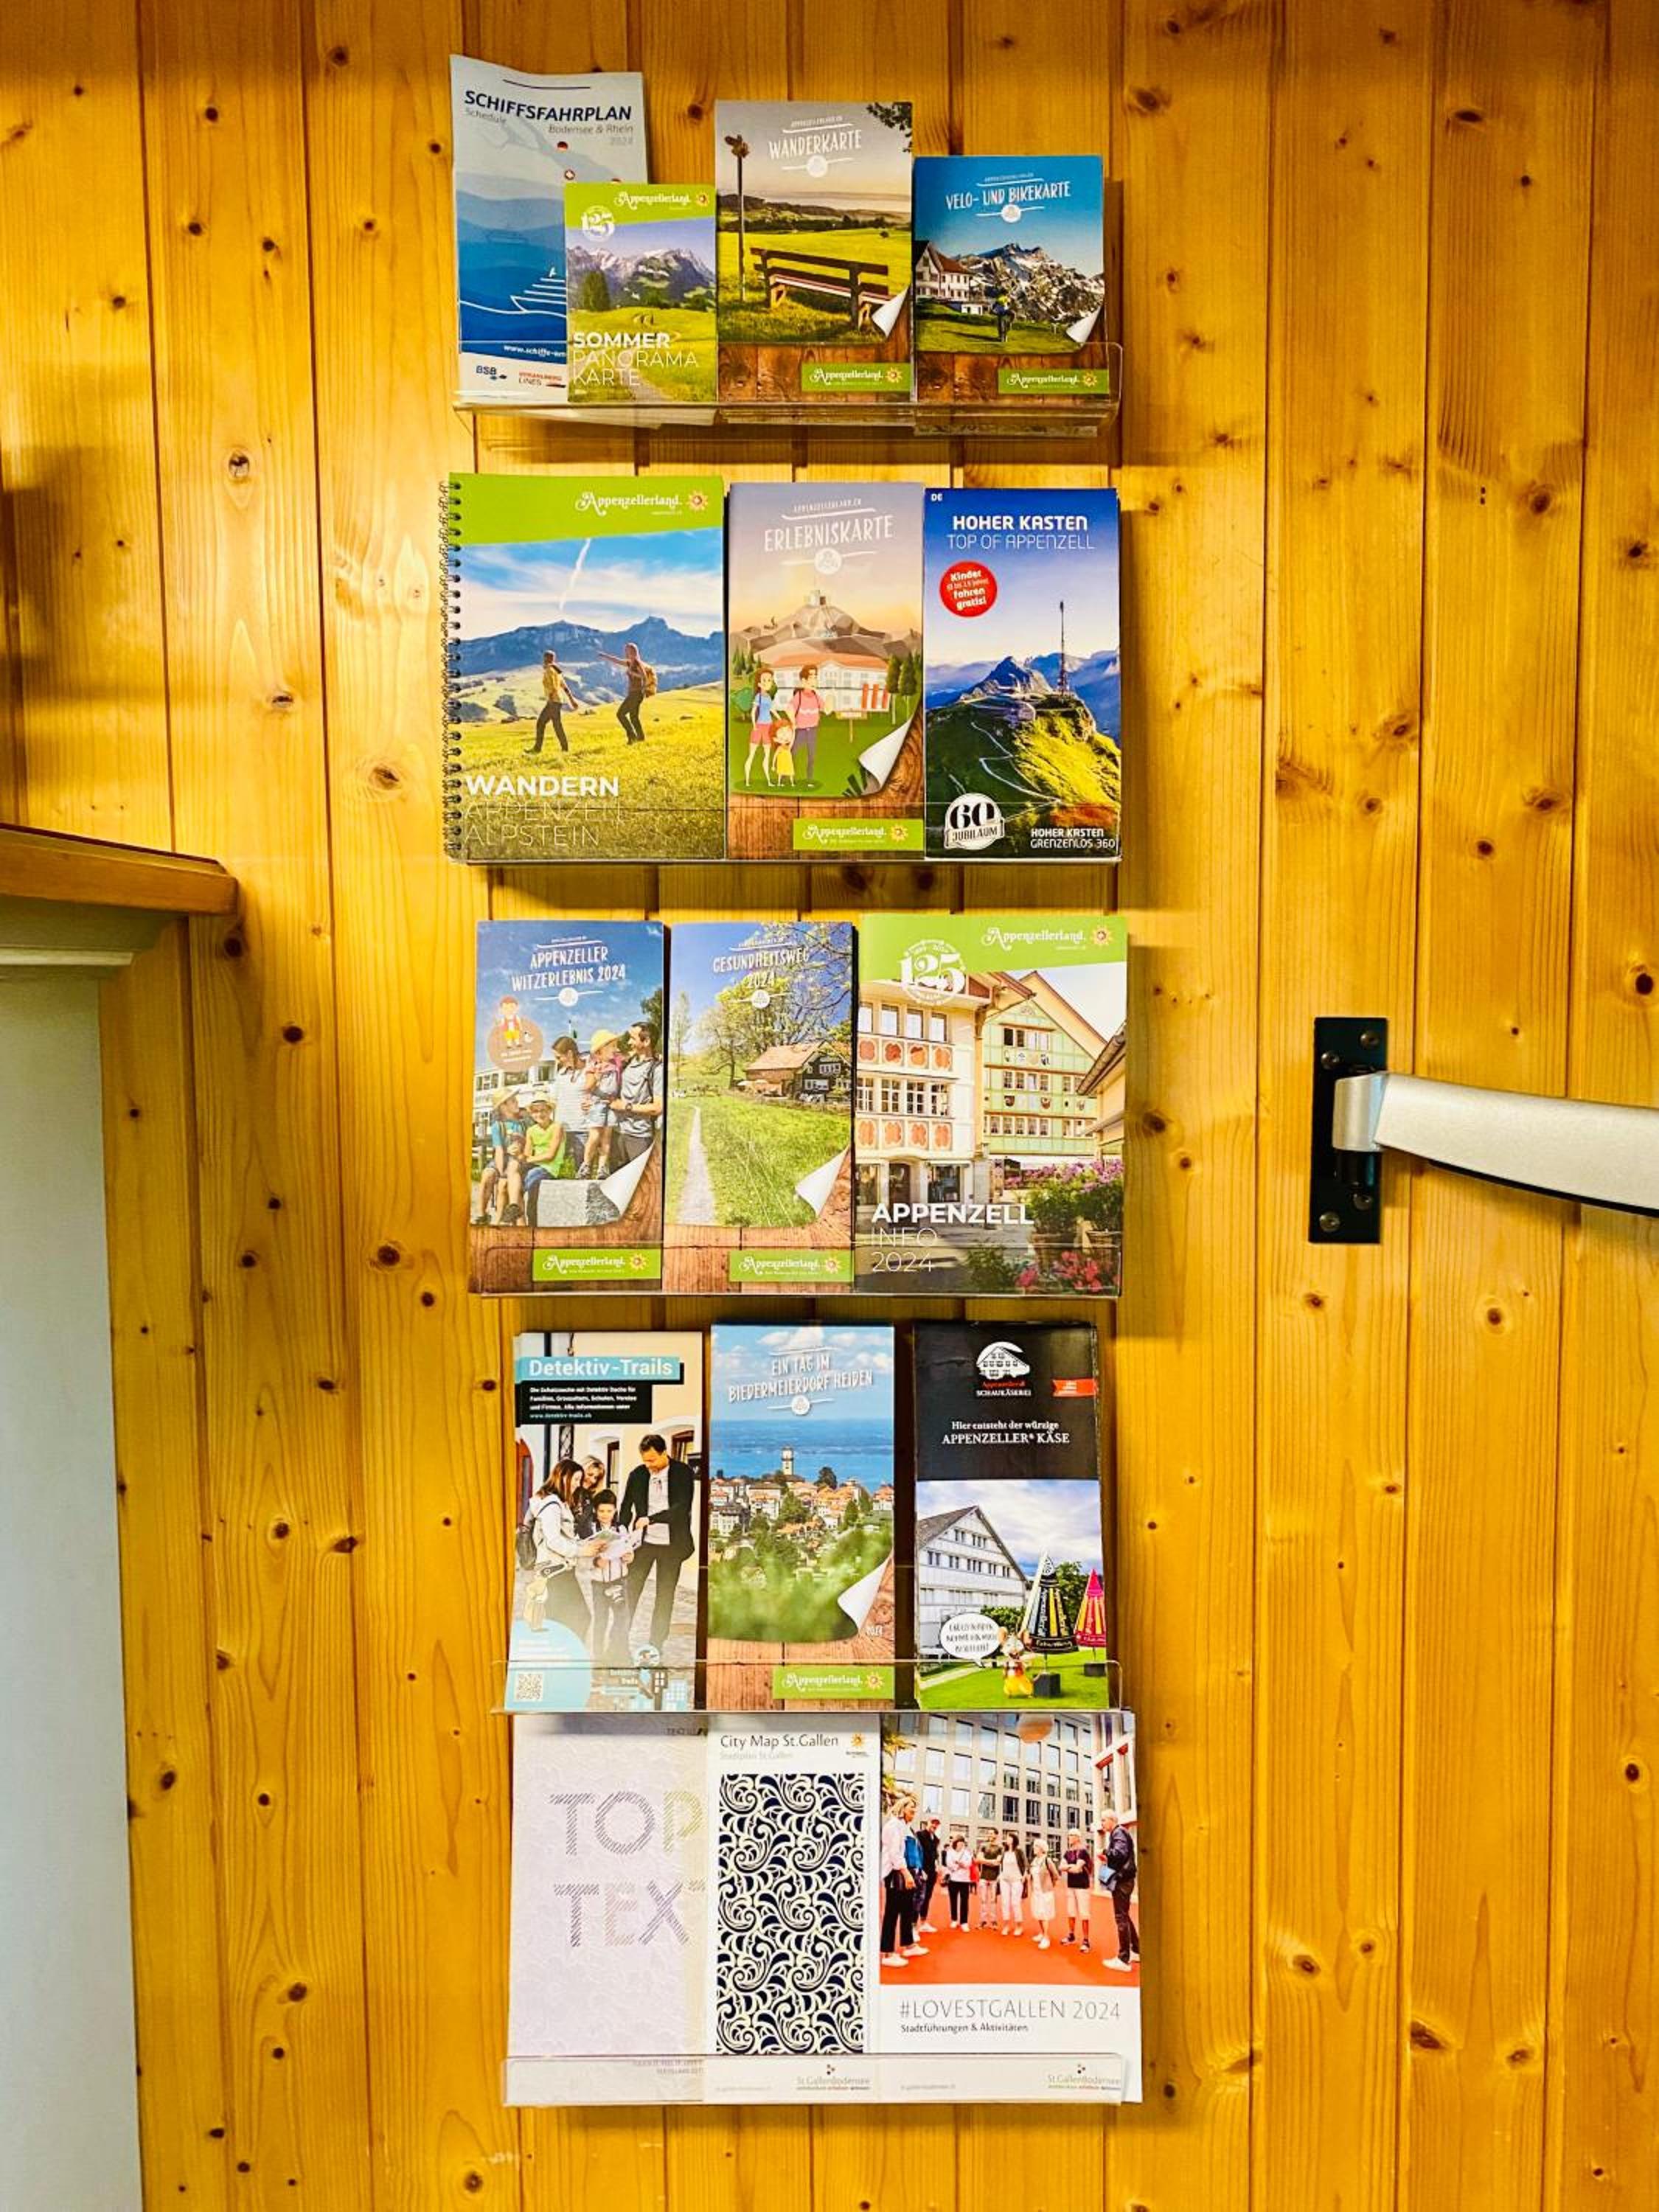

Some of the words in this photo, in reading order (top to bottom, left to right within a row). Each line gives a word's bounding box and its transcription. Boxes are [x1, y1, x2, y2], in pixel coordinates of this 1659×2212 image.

[465, 90, 632, 122] SCHIFFSFAHRPLAN
[549, 123, 594, 133] Bodensee
[596, 124, 604, 133] &
[606, 123, 634, 133] Rhein
[768, 129, 863, 160] WANDERKARTE
[946, 192, 979, 211] VELO-
[983, 188, 1005, 206] UND
[1008, 181, 1071, 203] BIKEKARTE
[573, 332, 670, 349] SOMMER
[573, 350, 700, 368] PANORAMA
[476, 365, 497, 375] BSB
[573, 369, 640, 386] KARTE
[931, 493, 943, 502] DE
[764, 515, 894, 552] ERLEBNISKARTE
[953, 515, 1015, 531] HOHER
[1020, 515, 1088, 532] KASTEN
[947, 534, 978, 550] TOP
[980, 534, 1002, 550] OF
[1005, 535, 1096, 550] APPENZELL
[950, 570, 981, 582] Kinder
[953, 588, 986, 599] fahren
[465, 775, 619, 797] WANDERN
[949, 802, 995, 830] 60
[465, 824, 599, 846] ALPSTEIN
[1030, 838, 1093, 849] GRENZENLOS
[1096, 838, 1116, 849] 360
[1031, 828, 1064, 838] HOHER
[1067, 828, 1105, 838] KASTEN
[530, 946, 608, 970] APPENZELLER
[712, 946, 810, 973] GESUNDHEITSWEG
[512, 967, 594, 992] WITZERLEBNIS
[597, 964, 627, 982] 2024
[747, 970, 775, 989] 2024
[899, 951, 967, 995] 125
[871, 1203, 1035, 1225] APPENZELL
[871, 1227, 938, 1248] INFO
[871, 1251, 934, 1273] 2024
[529, 1358, 673, 1377] Detektiv-Trails
[771, 1359, 789, 1377] EIN
[794, 1355, 814, 1374] TAG
[816, 1353, 830, 1371] IM
[728, 1375, 830, 1402] BIEDERMEIERDORF
[834, 1369, 874, 1389] HEIDEN
[951, 1421, 972, 1430] Hier
[973, 1421, 1007, 1430] entsteht
[1009, 1421, 1023, 1430] der
[1025, 1421, 1060, 1433] würzige
[1037, 1430, 1070, 1444] KÄSE
[720, 1735, 747, 1750] City
[750, 1735, 779, 1750] Map
[782, 1733, 839, 1747] St.Gallen
[550, 1790, 703, 1856] TOP
[553, 1879, 706, 1947] TEX
[900, 1999, 1066, 2019] #LOVESTGALLEN
[1073, 2000, 1121, 2020] 2024
[900, 2023, 969, 2034] Stadtführungen
[971, 2024, 978, 2032] &
[980, 2023, 1029, 2033] Aktivitäten
